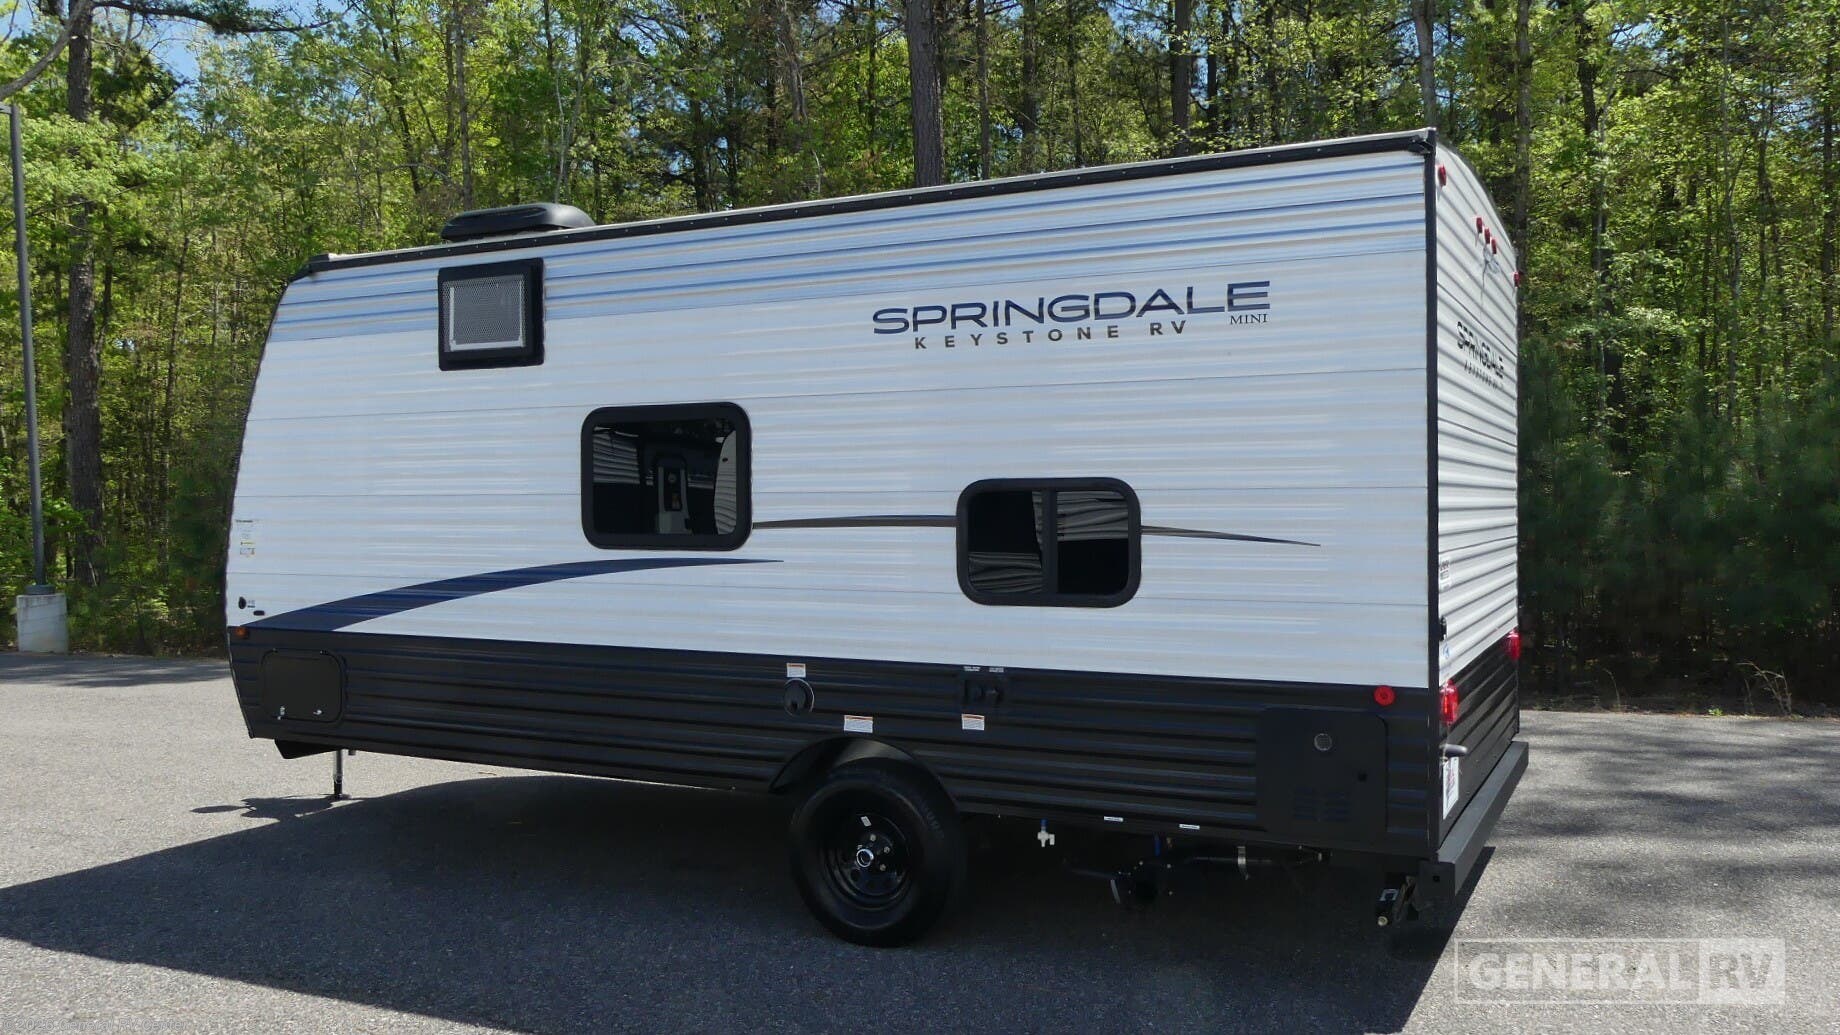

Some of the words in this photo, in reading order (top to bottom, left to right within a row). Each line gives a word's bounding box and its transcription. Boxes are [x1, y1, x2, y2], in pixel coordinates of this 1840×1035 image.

[872, 280, 1271, 334] SPRINGDALE
[1229, 312, 1269, 325] MINI
[915, 324, 1119, 349] KEYSTONE
[1150, 320, 1187, 336] RV
